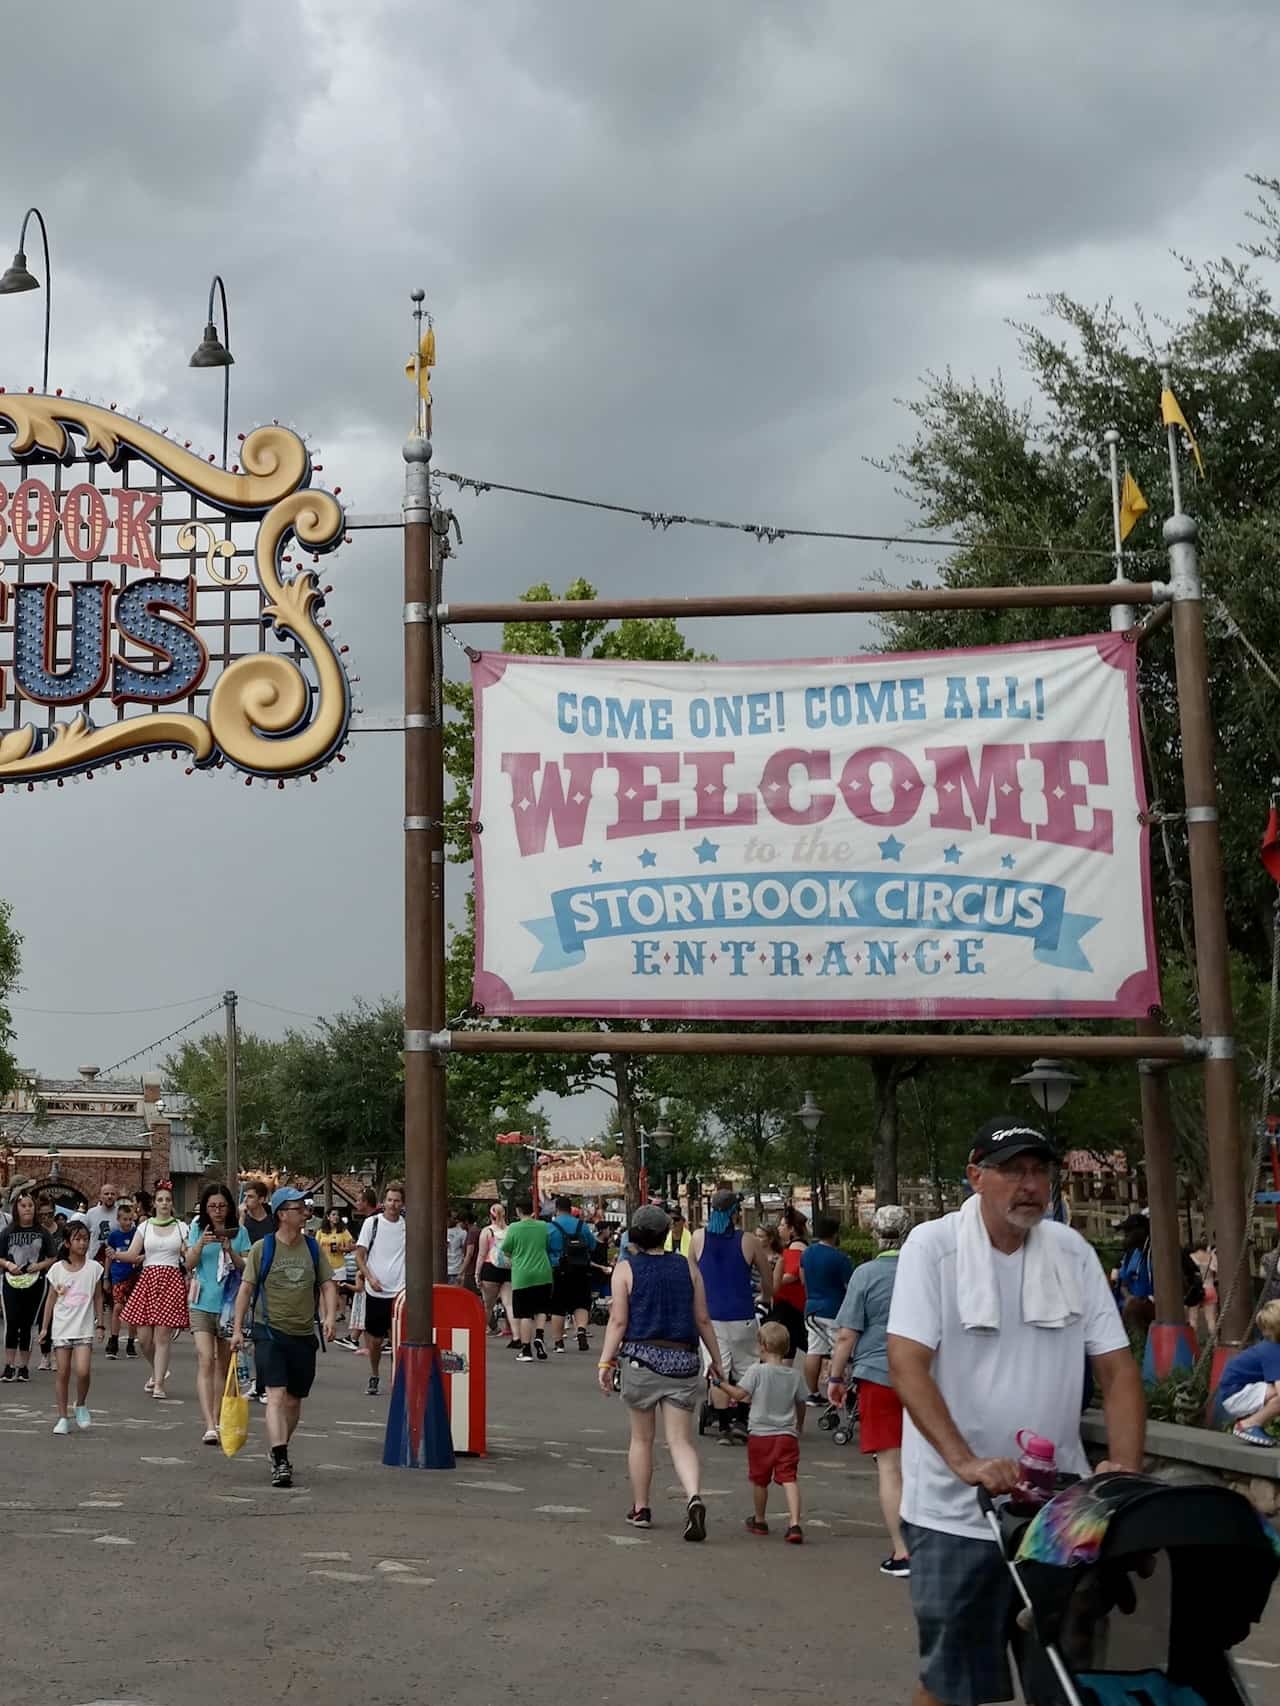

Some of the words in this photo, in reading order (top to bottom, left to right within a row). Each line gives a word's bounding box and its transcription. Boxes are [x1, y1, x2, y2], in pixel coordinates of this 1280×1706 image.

[557, 692, 673, 741] COME
[688, 690, 786, 739] ONE!
[804, 678, 927, 730] COME
[944, 675, 1046, 722] ALL!
[501, 740, 1115, 857] WELCOME
[743, 835, 776, 864] to
[792, 823, 854, 865] the
[569, 878, 859, 932] STORYBOOK
[875, 879, 1045, 929] CIRCUS
[632, 938, 986, 977] ENTRANCE
[552, 1170, 624, 1184] BARNSTORM
